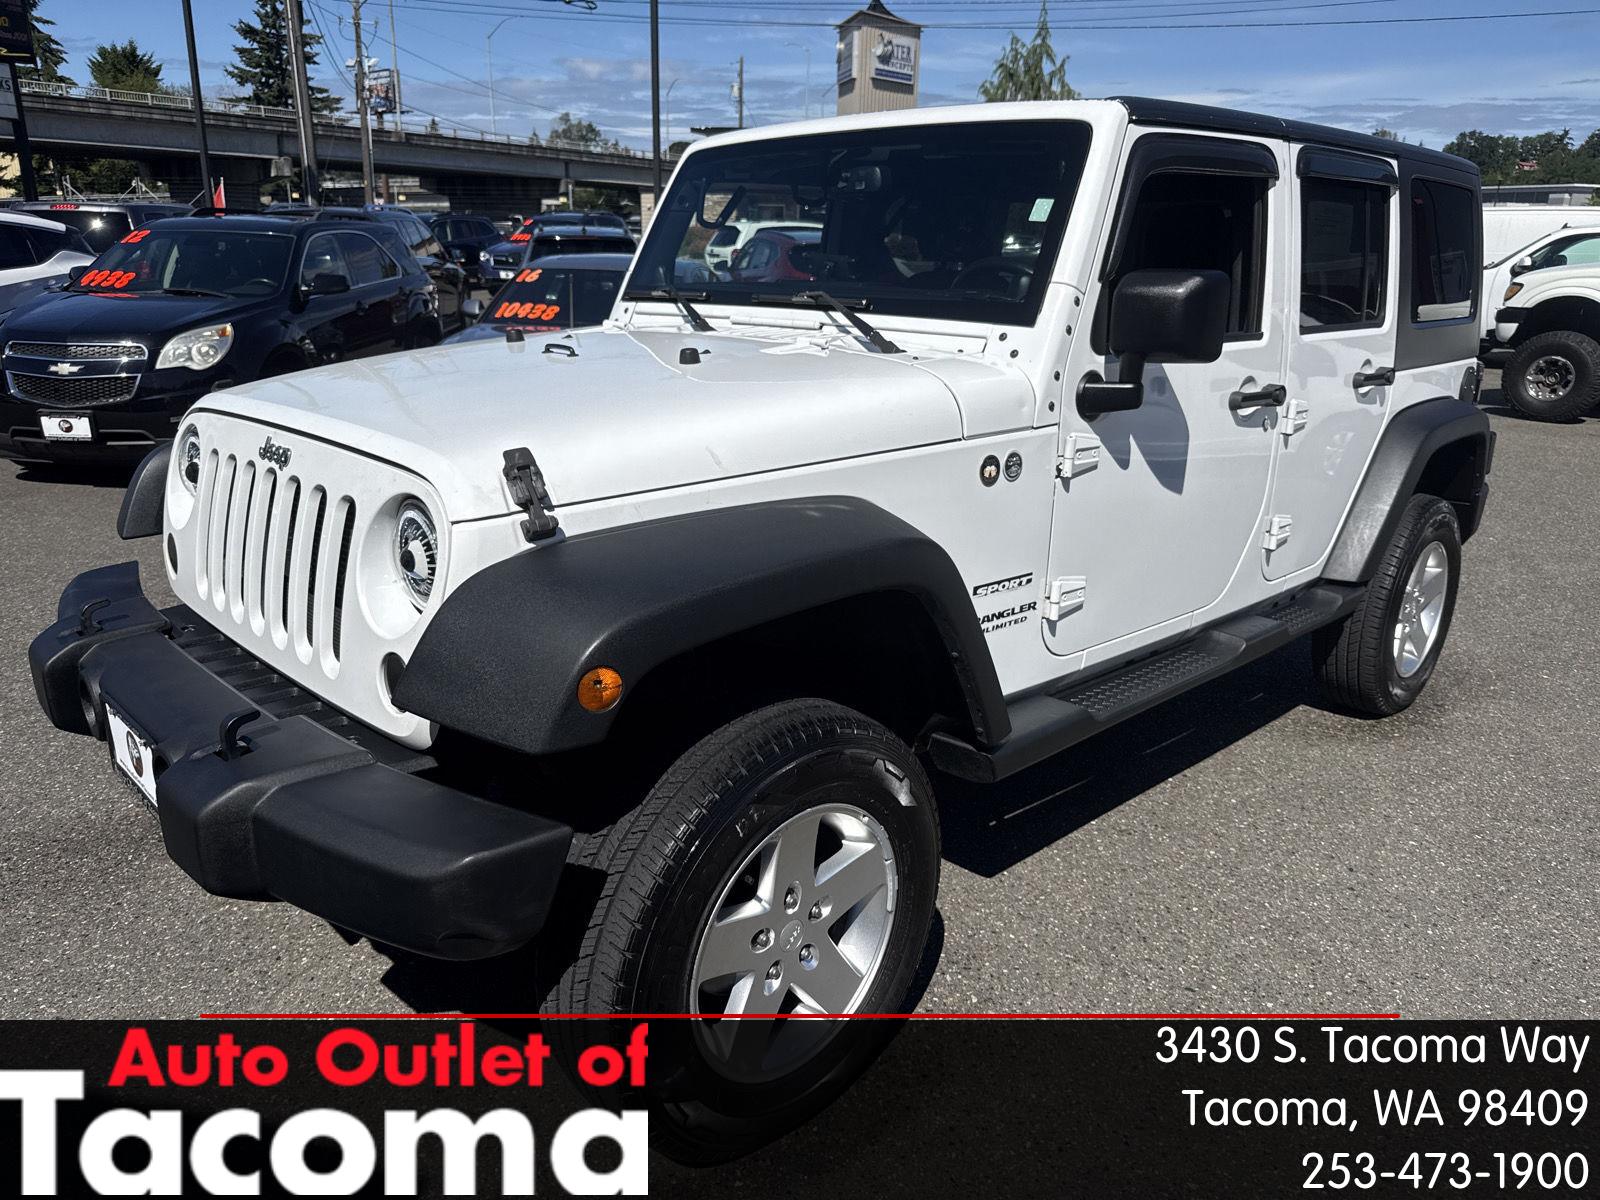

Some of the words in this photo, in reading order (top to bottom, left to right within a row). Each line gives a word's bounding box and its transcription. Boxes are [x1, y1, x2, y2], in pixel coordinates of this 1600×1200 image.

[120, 229, 151, 244] 12
[516, 268, 543, 283] 16
[258, 435, 293, 472] Jeep
[974, 573, 1033, 597] SPORT
[978, 601, 1037, 625] ANGLER
[983, 616, 1027, 633] LIMITED
